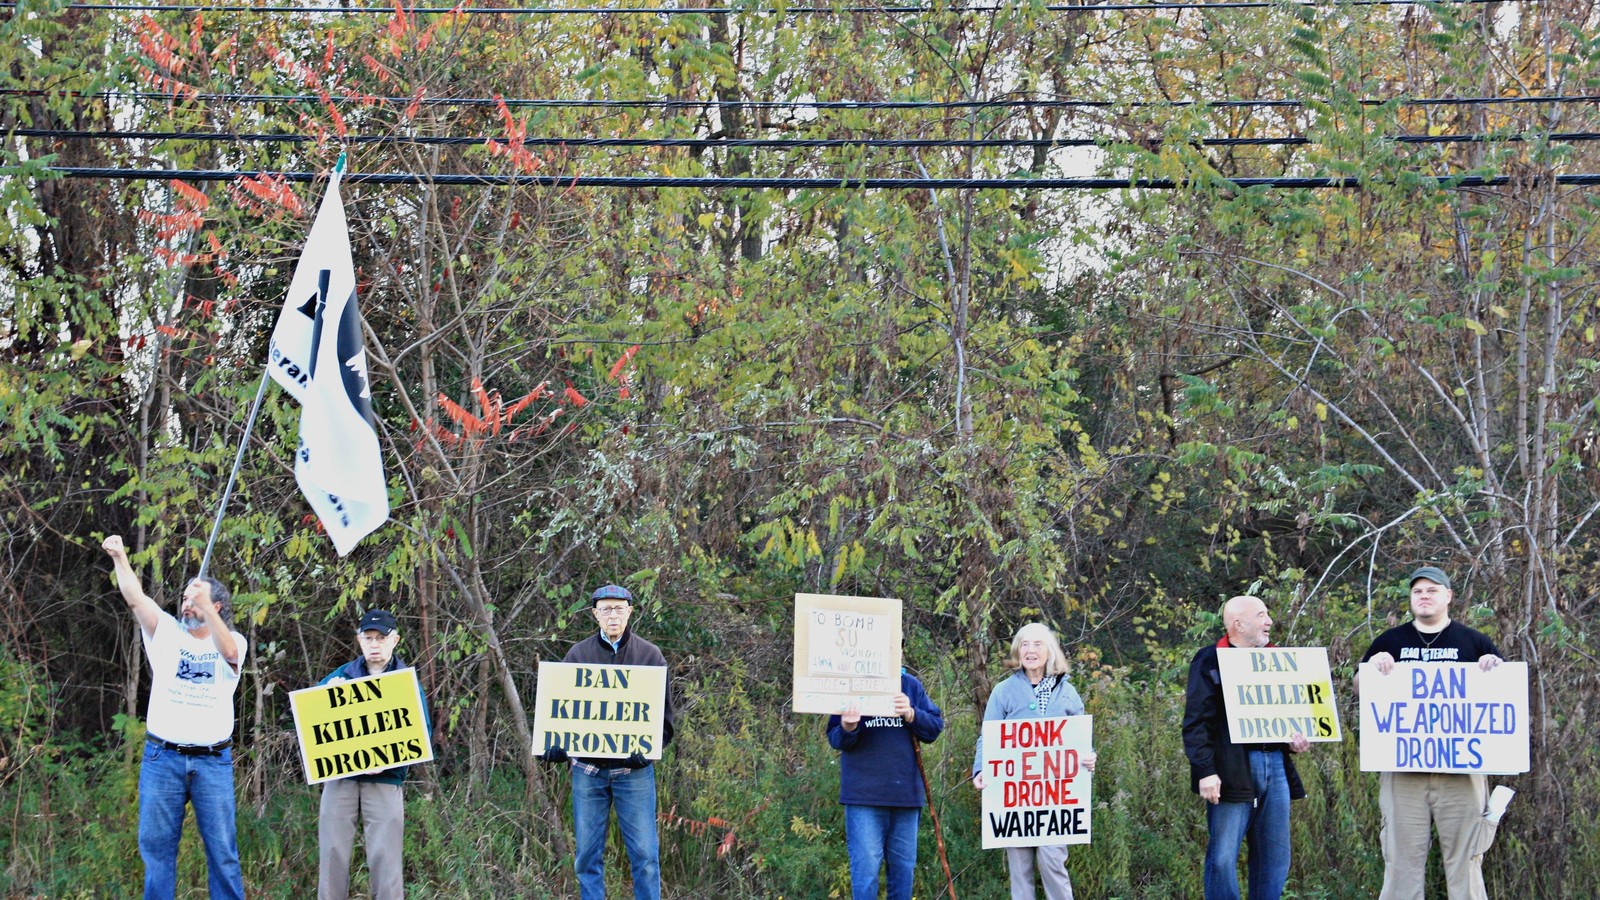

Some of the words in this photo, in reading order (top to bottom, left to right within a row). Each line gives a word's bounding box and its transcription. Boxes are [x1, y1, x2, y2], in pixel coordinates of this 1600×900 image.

[812, 611, 826, 625] TO
[834, 613, 874, 630] BOMB
[1250, 651, 1298, 673] BAN
[574, 667, 631, 689] BAN
[1412, 667, 1466, 700] BAN
[327, 678, 383, 709] BAN
[1236, 684, 1324, 706] KILLER
[550, 698, 651, 723] KILLER
[865, 716, 904, 728] without
[1370, 702, 1516, 735] WEAPONIZED
[312, 707, 413, 745] KILLER
[1000, 719, 1068, 749] HONK
[1238, 716, 1333, 739] DRONES
[543, 731, 653, 755] DRONES
[1396, 737, 1483, 769] DRONES
[315, 738, 423, 779] DRONES
[988, 759, 1015, 778] TO
[1021, 749, 1079, 780] END
[1004, 779, 1078, 808] DRONE
[989, 808, 1088, 838] WARFARE
